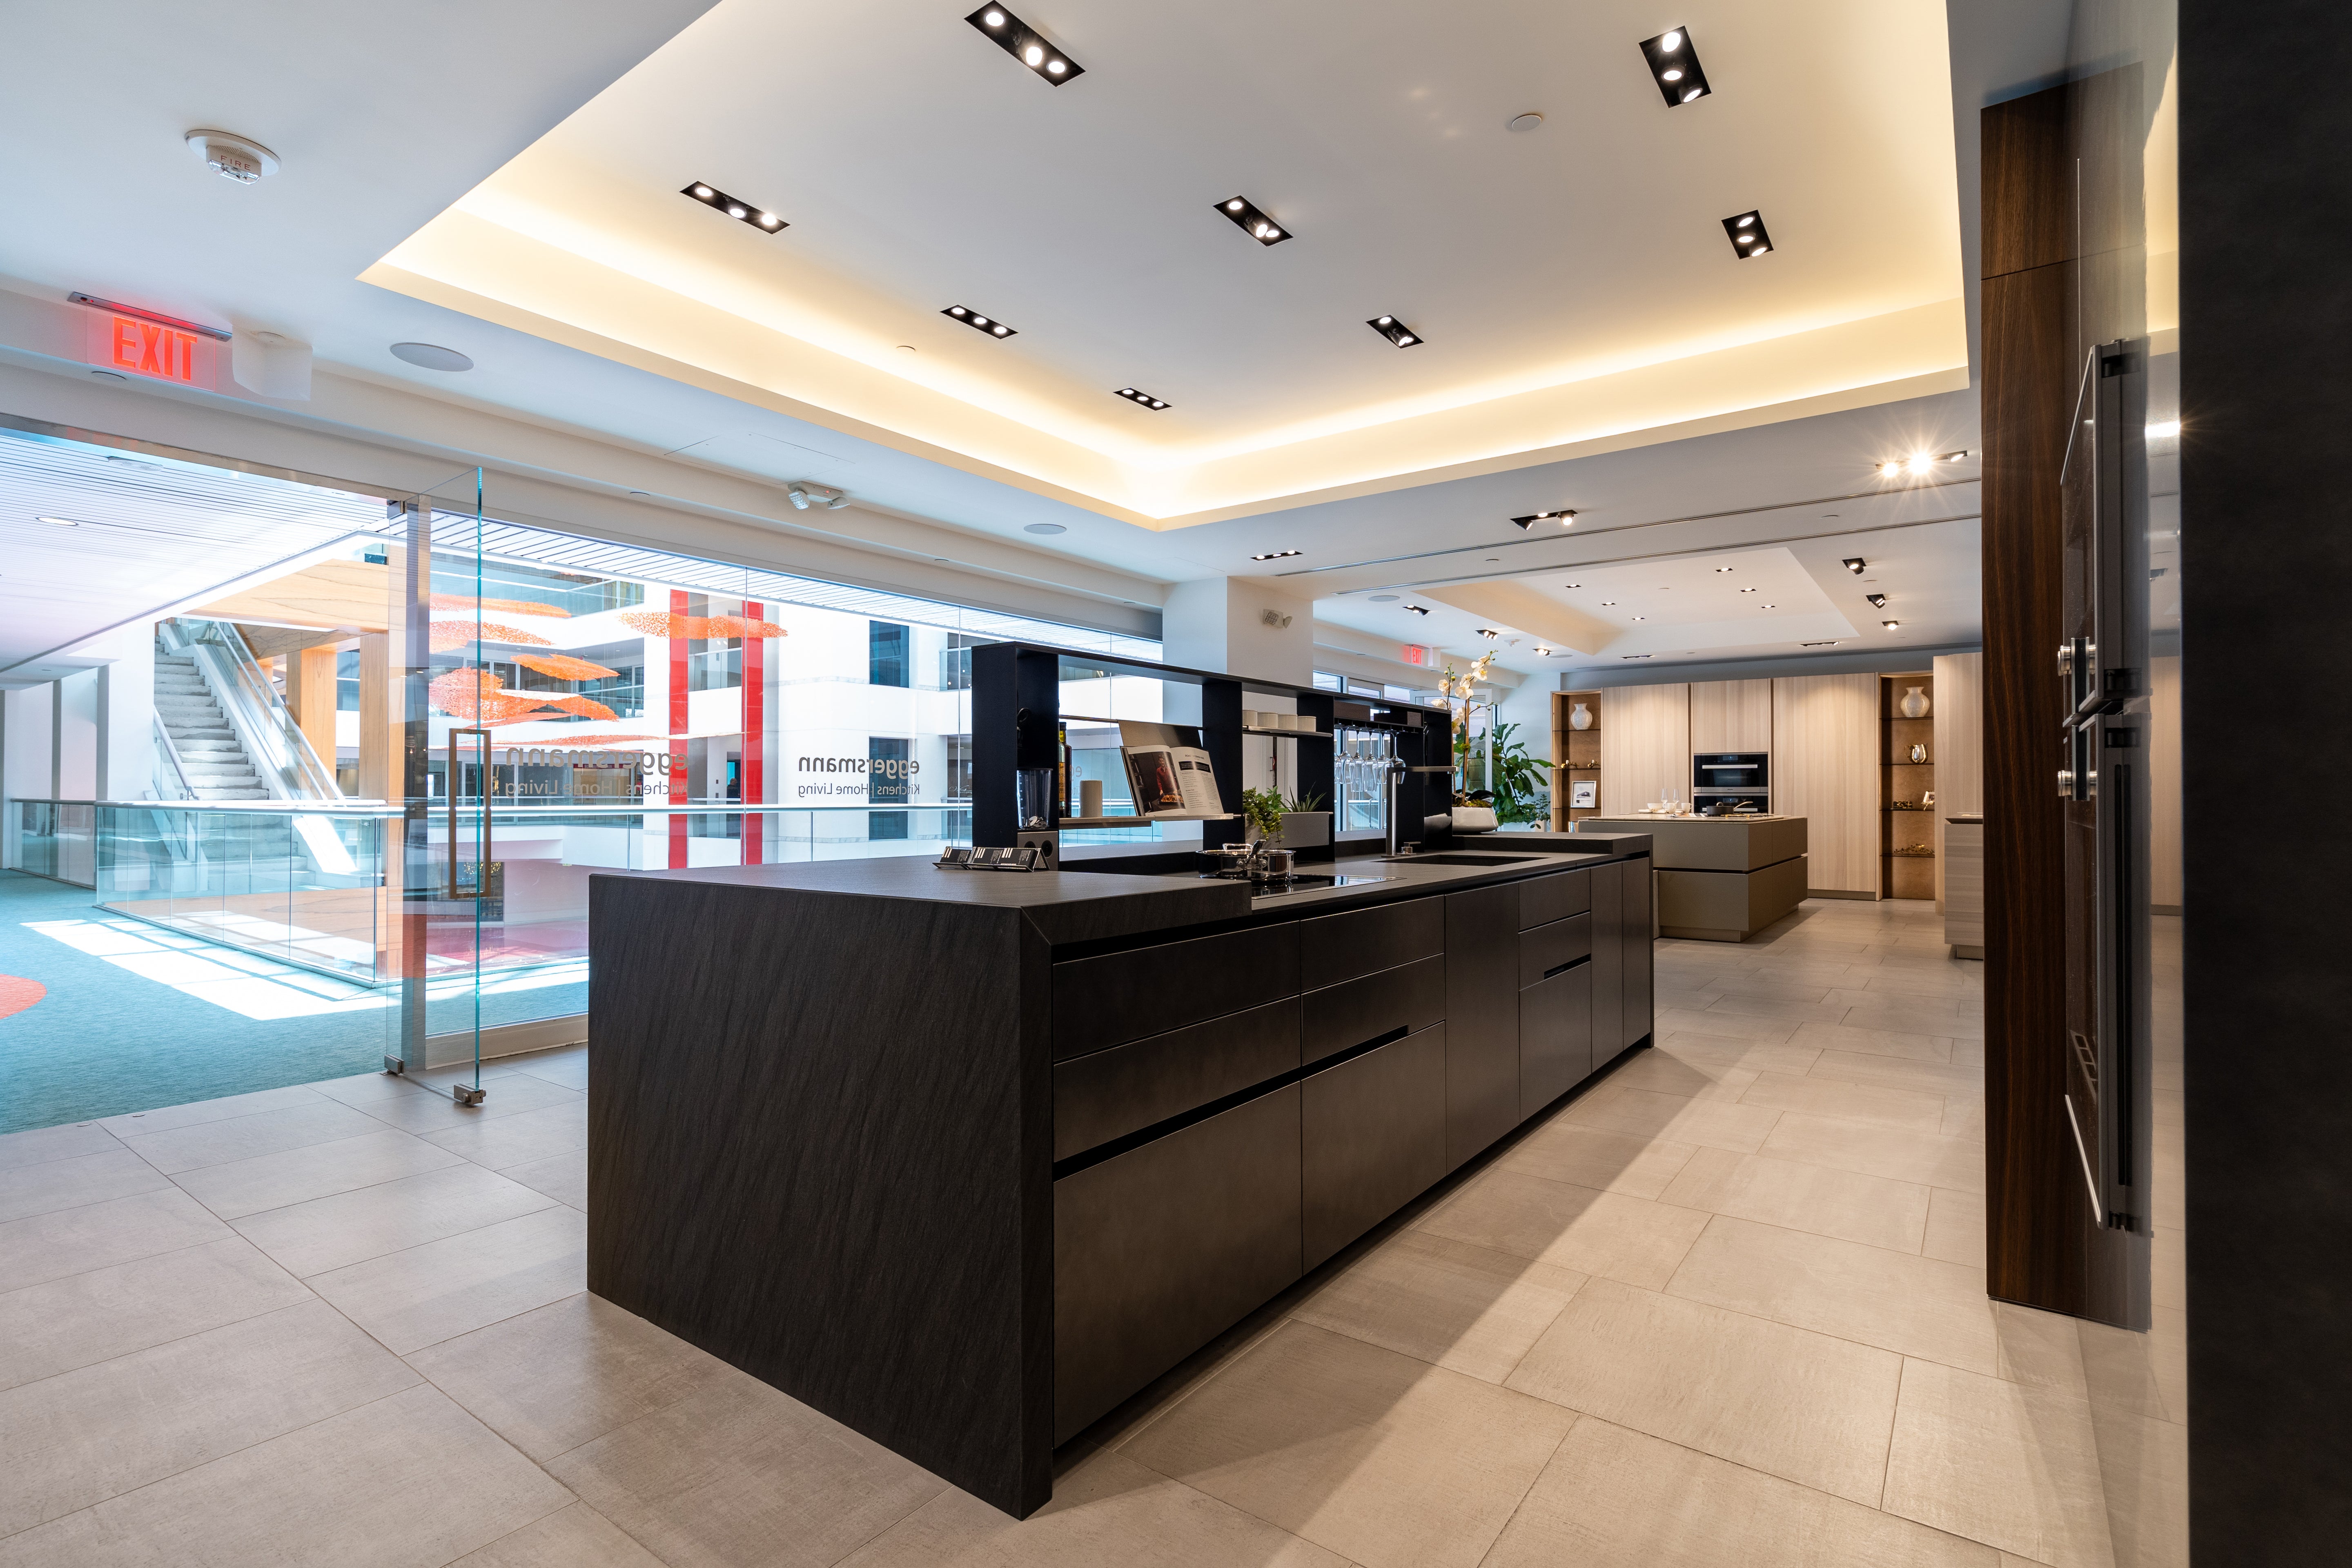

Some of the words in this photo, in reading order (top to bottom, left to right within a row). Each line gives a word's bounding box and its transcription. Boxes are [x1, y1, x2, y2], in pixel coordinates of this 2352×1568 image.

[221, 155, 251, 171] FIRE
[113, 315, 197, 381] EXIT
[1412, 647, 1422, 665] EXIT
